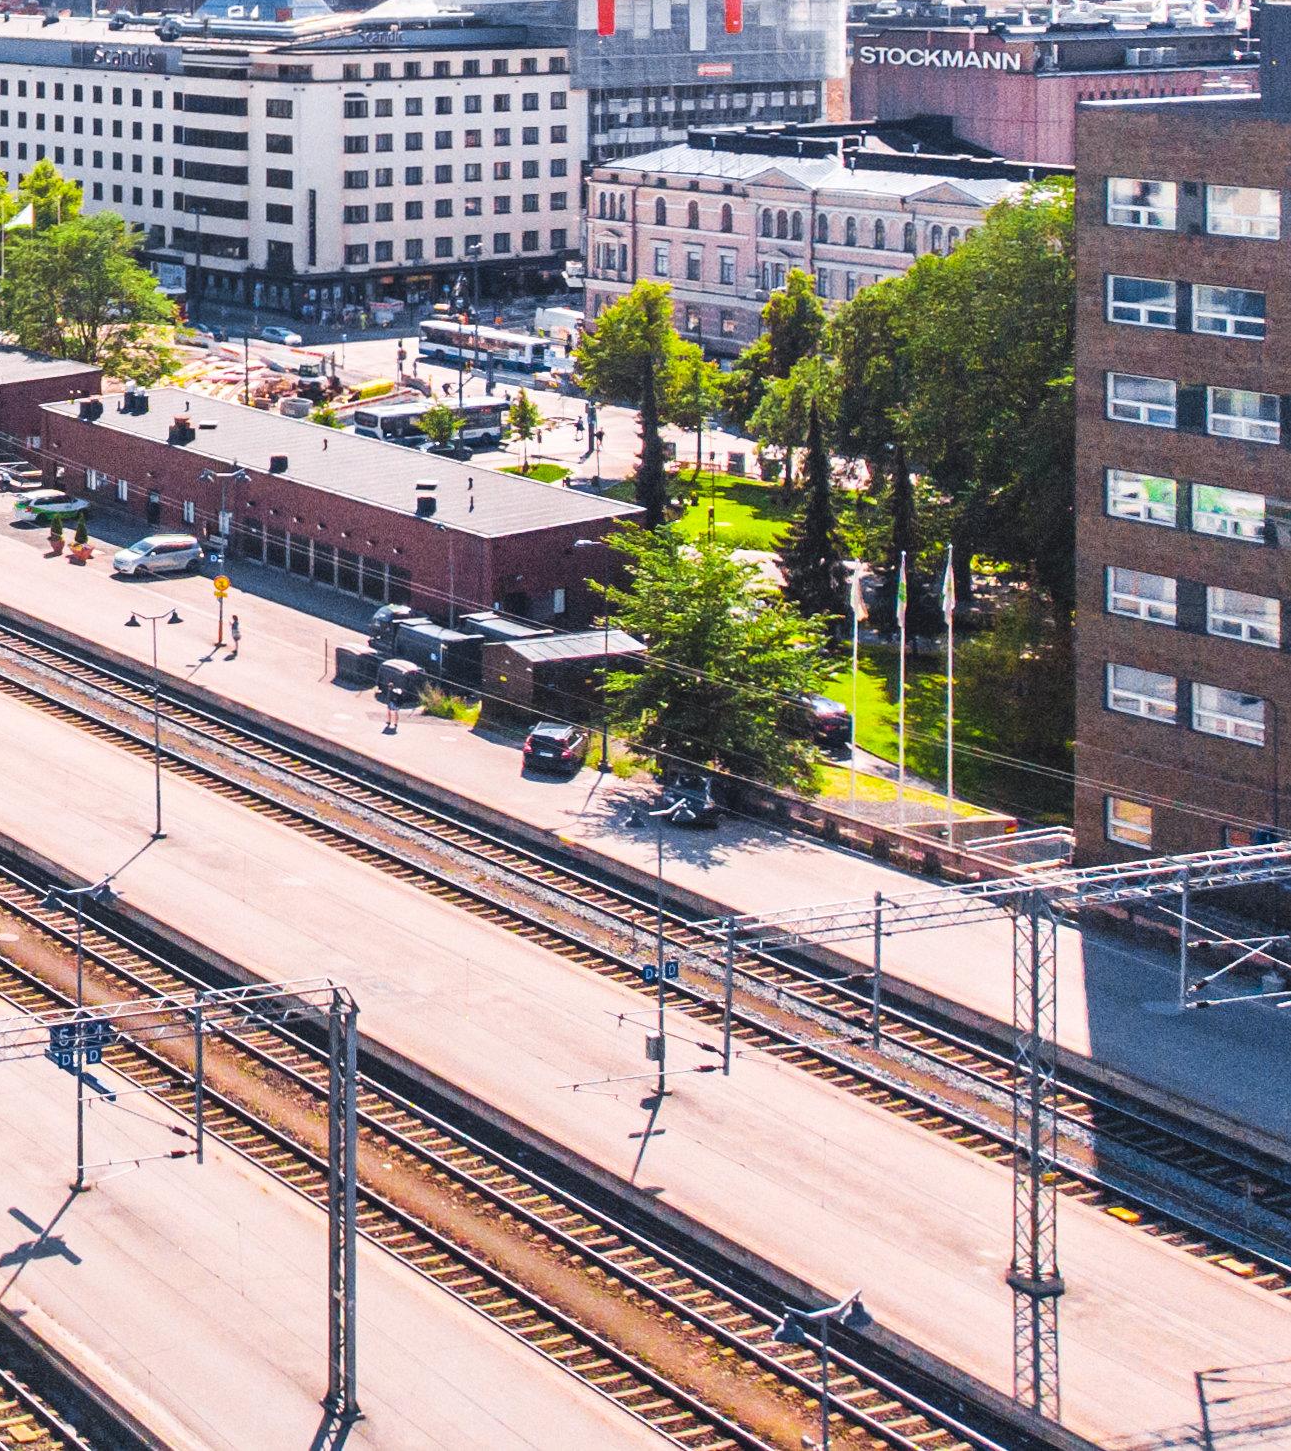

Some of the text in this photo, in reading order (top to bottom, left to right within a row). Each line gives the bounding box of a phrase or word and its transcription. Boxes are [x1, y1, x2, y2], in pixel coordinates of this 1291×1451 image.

[93, 45, 156, 67] Scandic
[860, 46, 1021, 71] STOCKMANN
[645, 968, 653, 980] D
[59, 1028, 69, 1047] 5
[62, 1054, 71, 1066] D
[90, 1050, 99, 1062] D
